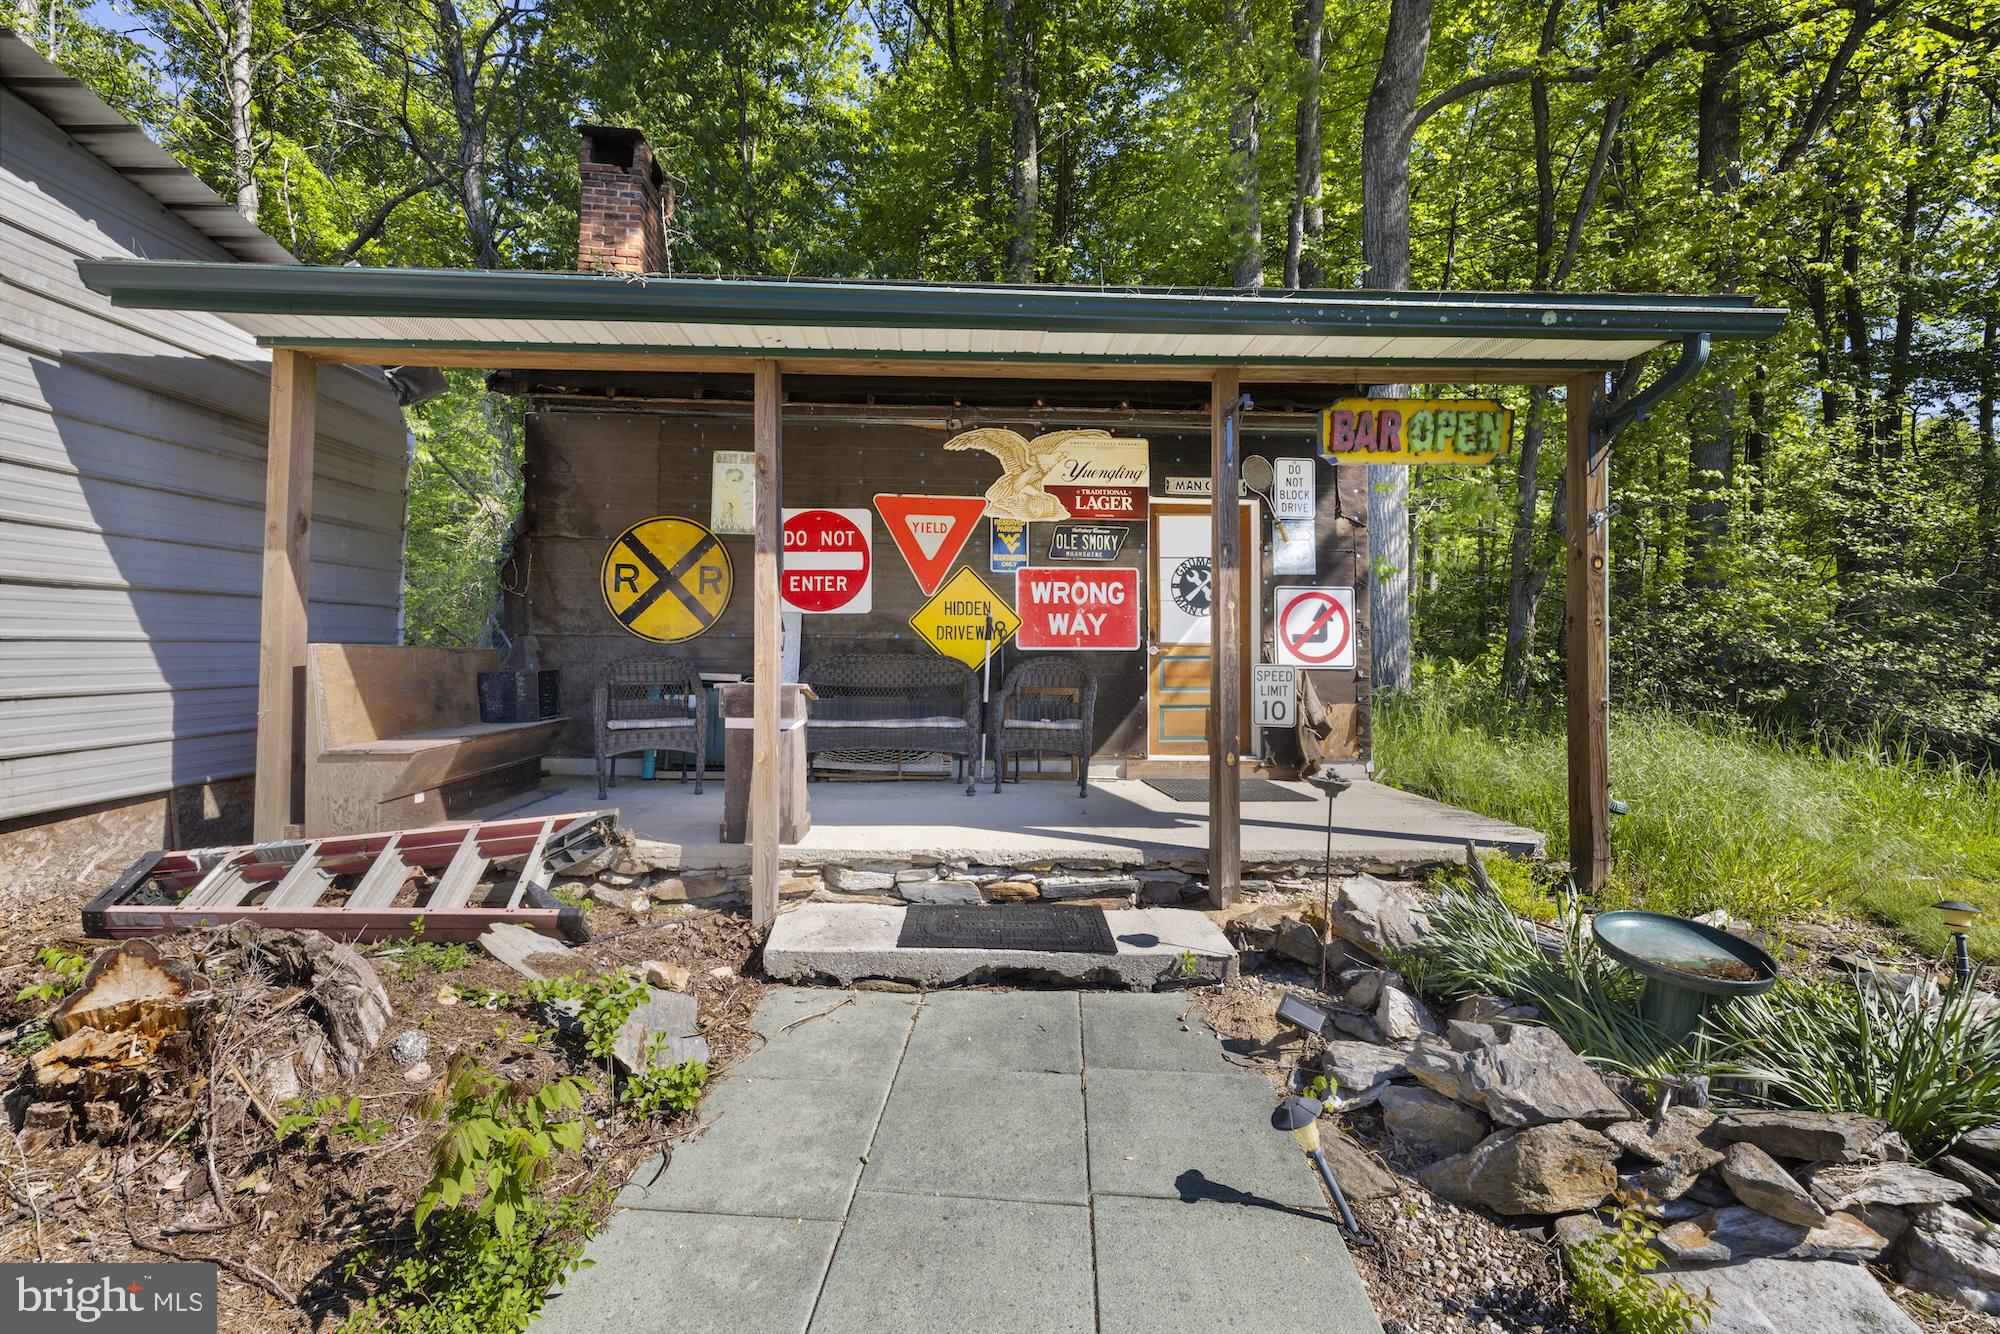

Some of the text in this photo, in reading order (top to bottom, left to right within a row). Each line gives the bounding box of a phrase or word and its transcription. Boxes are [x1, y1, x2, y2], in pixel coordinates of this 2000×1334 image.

[1330, 408, 1505, 456] BAR OPEN
[1061, 459, 1148, 484] Yuengling
[1288, 464, 1301, 475] DO
[1174, 481, 1202, 491] MAN
[1285, 477, 1304, 487] NOT
[1279, 490, 1310, 500] BLOCK
[1074, 496, 1134, 511] LAGER
[1281, 502, 1309, 513] DRIVE
[912, 521, 948, 534] YIELD
[783, 530, 856, 546] DO NOT
[1055, 533, 1119, 551] OLE SMOKY
[1176, 557, 1212, 577] GRUMP
[613, 563, 724, 596] R R
[789, 575, 848, 592] ENTER
[1030, 581, 1126, 605] WRONG
[944, 601, 991, 616] HIDDEN
[1174, 596, 1198, 615] MAN
[1047, 612, 1108, 636] WAY
[936, 625, 999, 640] DRIVEWY
[1256, 670, 1293, 682] SPEED
[1260, 685, 1289, 697] LIMIT
[1262, 700, 1286, 721] 10
